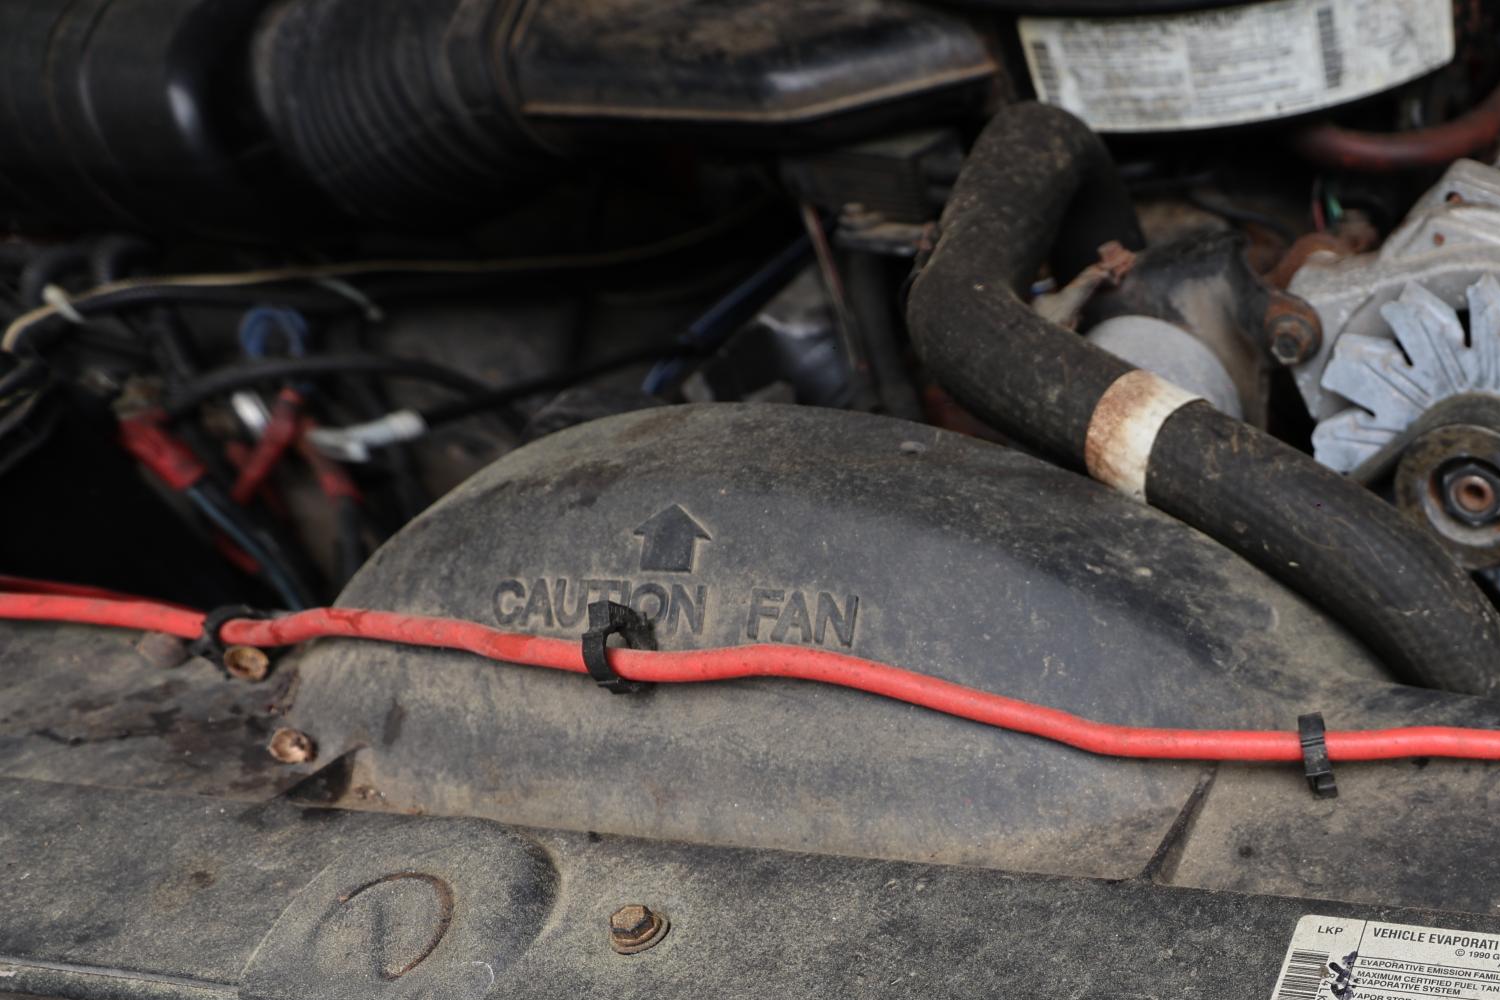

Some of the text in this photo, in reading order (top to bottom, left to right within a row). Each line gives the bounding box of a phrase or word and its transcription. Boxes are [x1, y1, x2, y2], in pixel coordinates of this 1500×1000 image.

[746, 586, 860, 648] FAN
[1316, 924, 1344, 935] LKP
[1371, 927, 1426, 942] VEHICLE
[1467, 950, 1490, 959] 1990
[1359, 958, 1425, 972] EVAPORATIVE
[1426, 965, 1472, 977] EMISSION
[1354, 977, 1461, 995] EVAPORATIVE SYSTEM
[1356, 970, 1401, 982] MAXIMUM
[1402, 975, 1452, 987] CERTIFIED
[1453, 980, 1479, 990] FUEL
